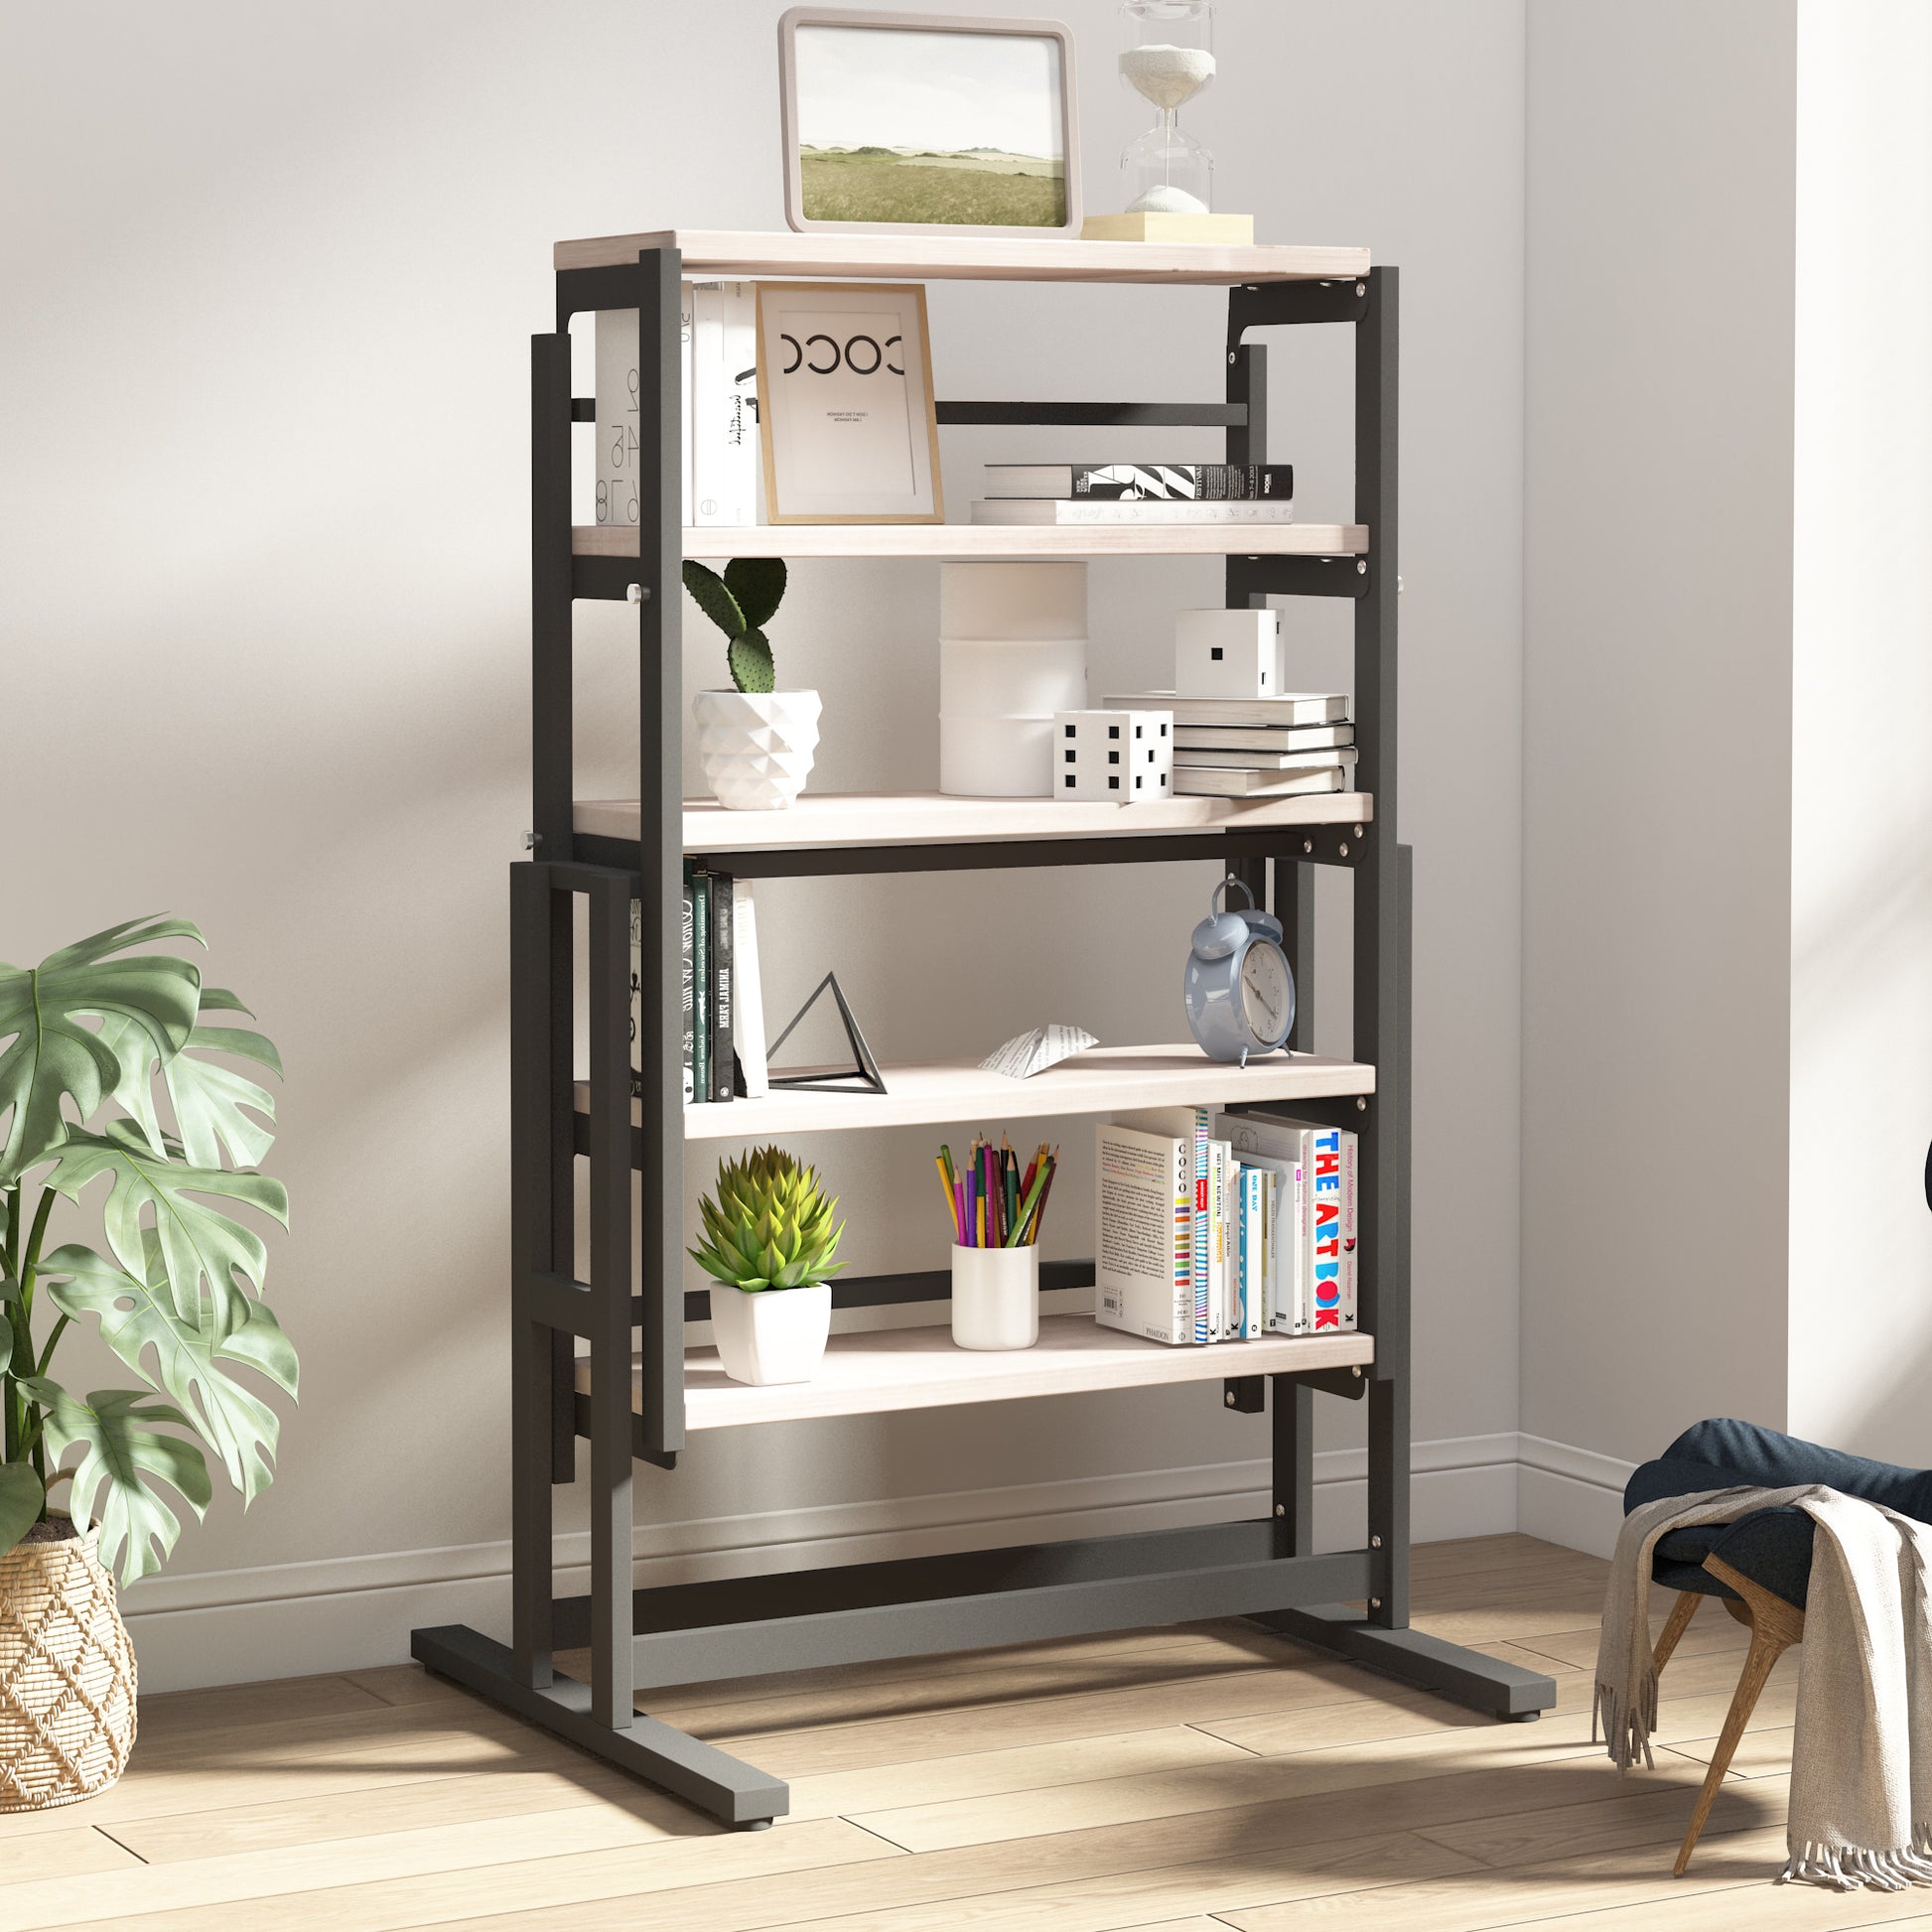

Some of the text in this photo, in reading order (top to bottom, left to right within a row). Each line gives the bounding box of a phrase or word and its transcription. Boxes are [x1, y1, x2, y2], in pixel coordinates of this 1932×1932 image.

[1178, 1144, 1187, 1193] COCO
[1315, 1131, 1339, 1192] THE
[1315, 1203, 1339, 1257] ART
[1315, 1262, 1340, 1330] BOOK
[1146, 1327, 1169, 1341] PHAIDON
